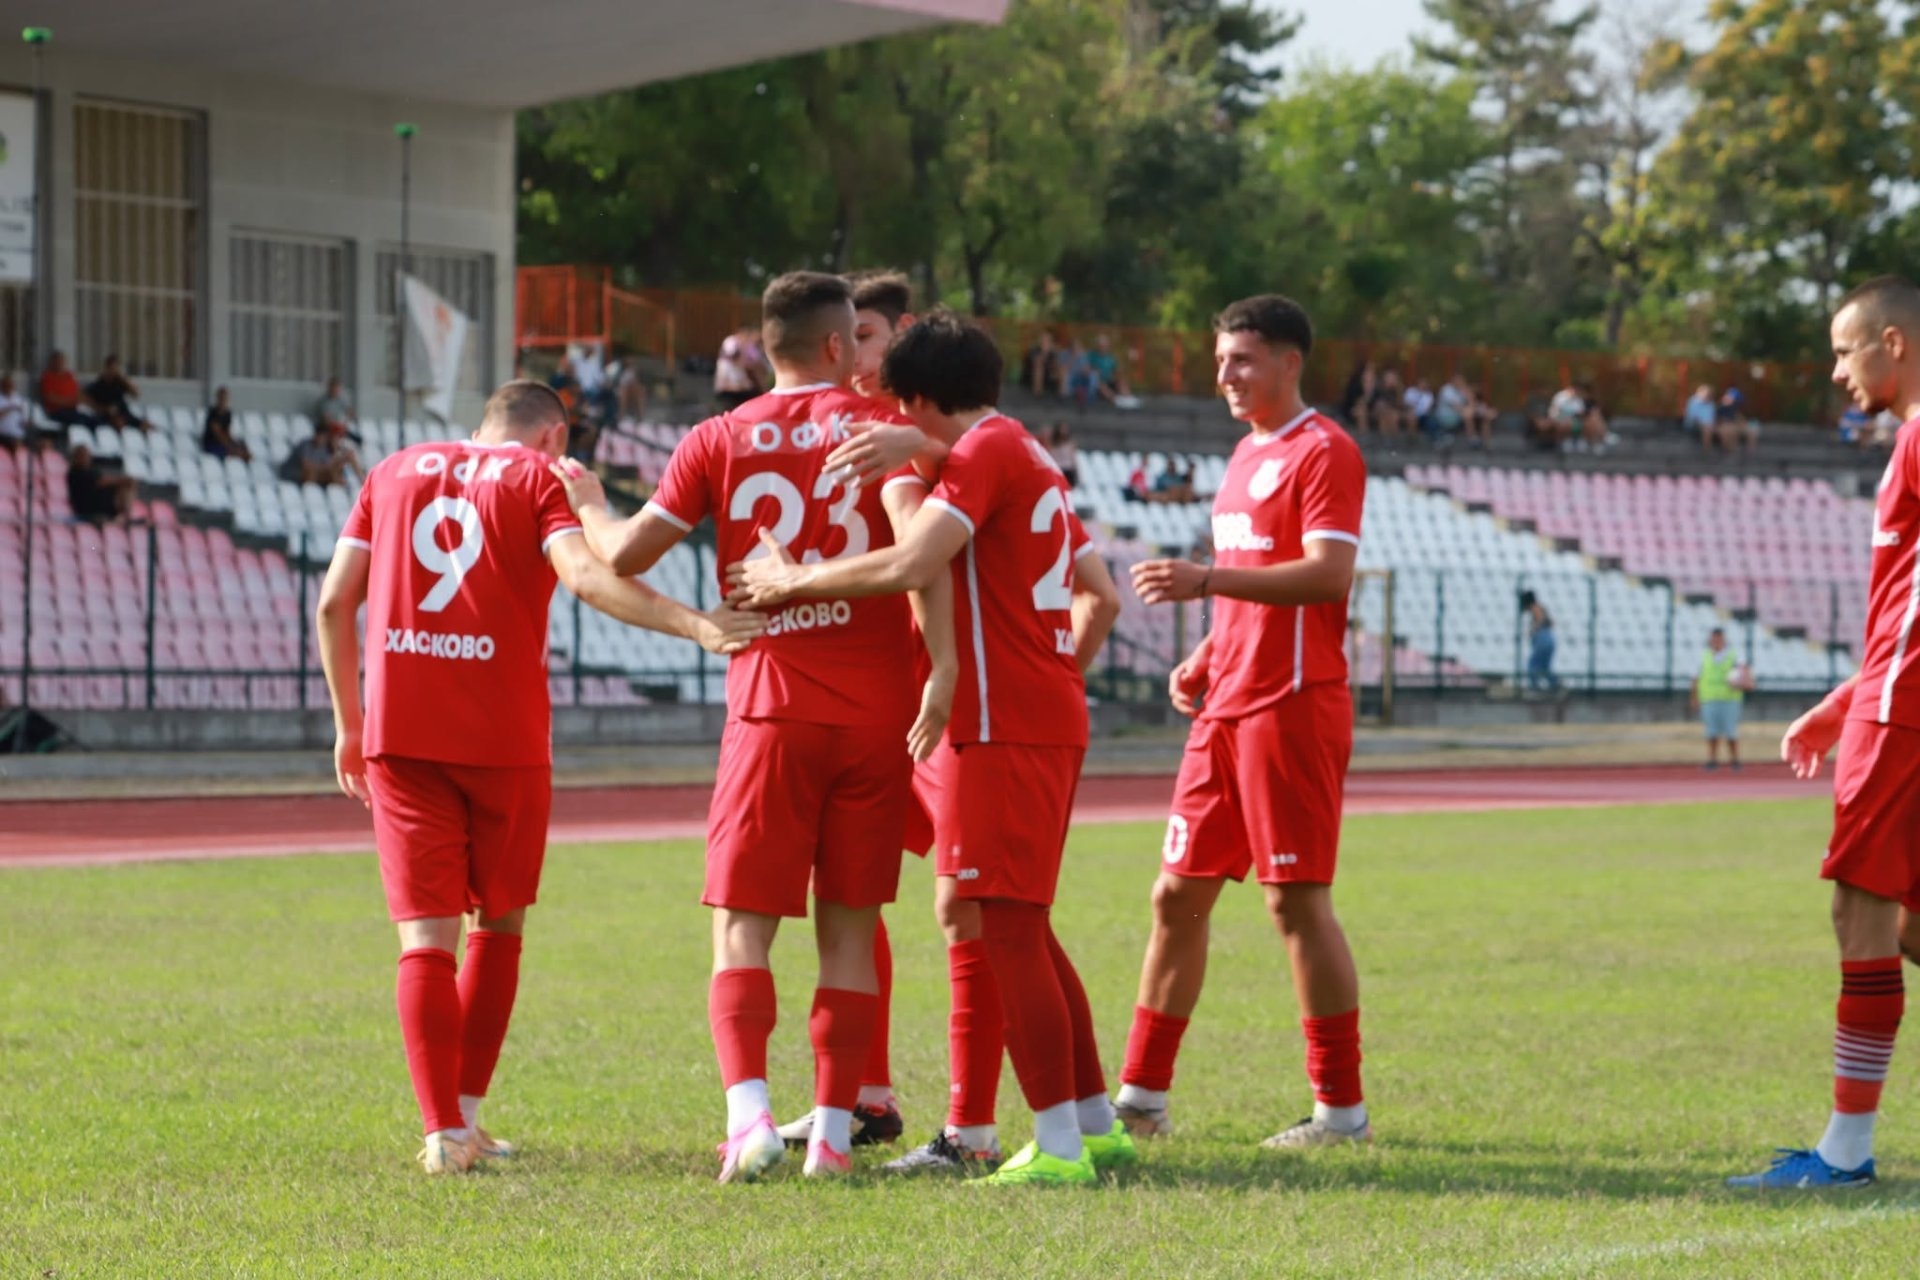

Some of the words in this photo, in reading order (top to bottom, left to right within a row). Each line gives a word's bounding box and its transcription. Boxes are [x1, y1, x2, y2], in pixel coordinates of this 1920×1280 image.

[751, 413, 855, 451] ОФК
[729, 466, 870, 565] 23
[1030, 485, 1076, 611] 2
[412, 495, 485, 613] 9
[385, 628, 496, 661] ХАСКОВО
[766, 599, 851, 636] СКОВО
